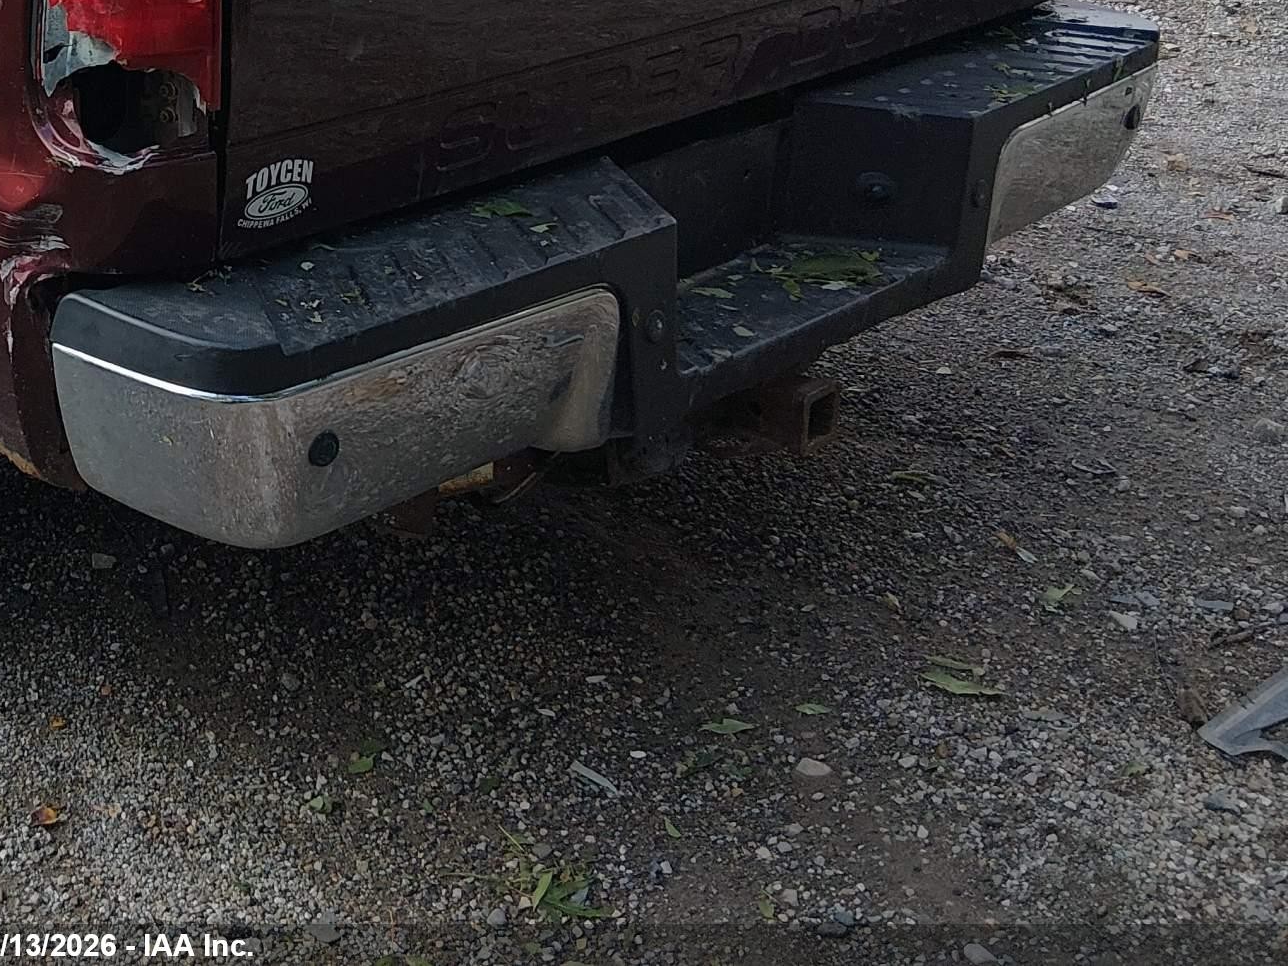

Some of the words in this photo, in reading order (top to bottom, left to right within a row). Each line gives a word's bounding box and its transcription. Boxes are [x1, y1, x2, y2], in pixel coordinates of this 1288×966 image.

[246, 159, 314, 200] TOYCEN
[237, 218, 275, 229] CHIPPEWA
[302, 197, 312, 210] WI
